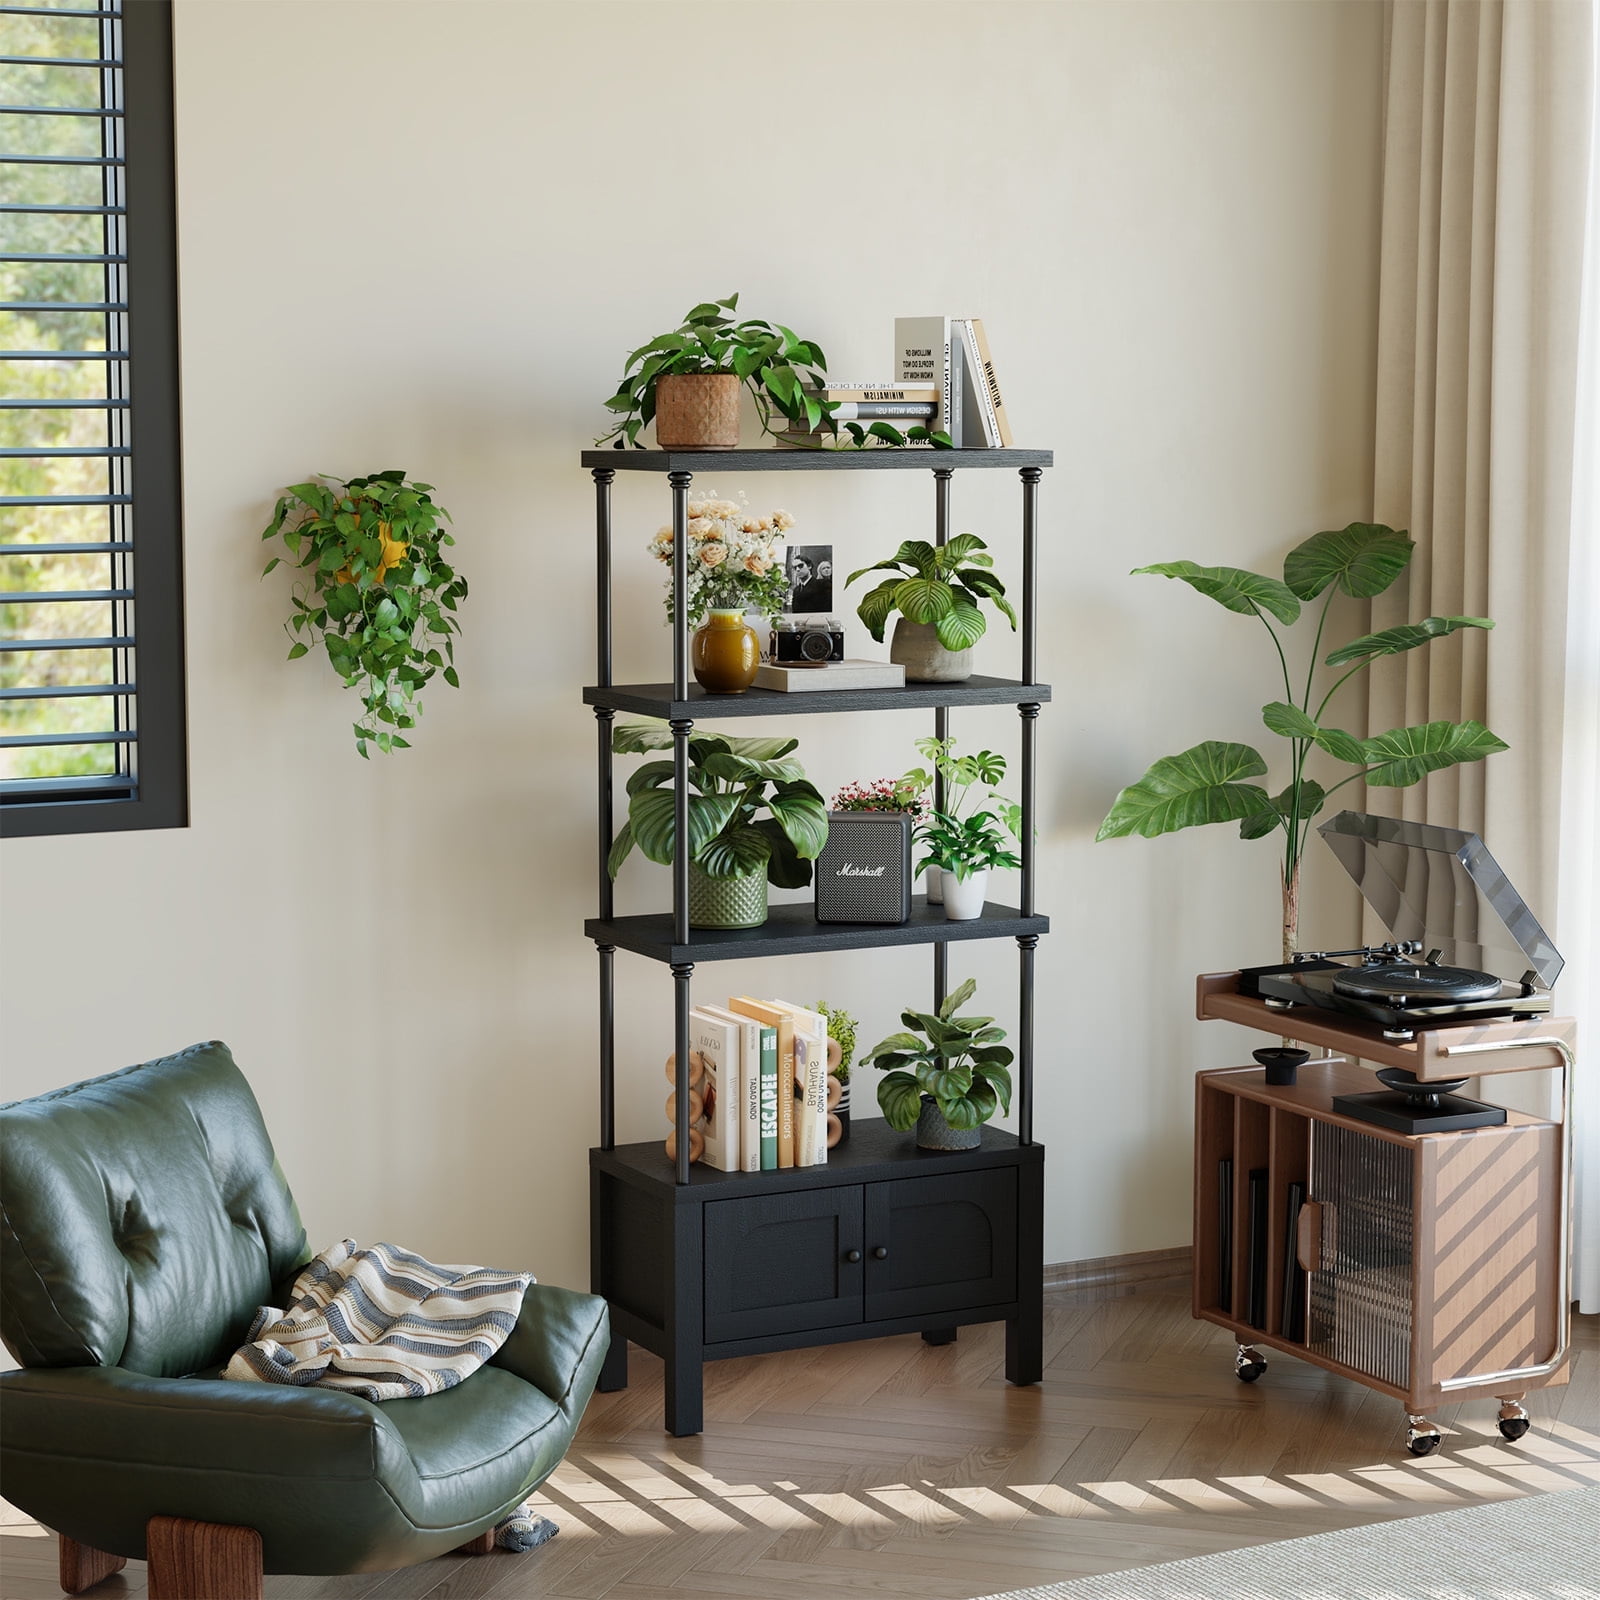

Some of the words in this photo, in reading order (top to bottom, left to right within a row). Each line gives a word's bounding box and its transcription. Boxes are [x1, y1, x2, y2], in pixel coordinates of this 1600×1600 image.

[836, 862, 885, 877] Marshall
[749, 1077, 757, 1100] TADAO
[749, 1101, 757, 1120] ANDO
[761, 1073, 778, 1138] ESCAPEE
